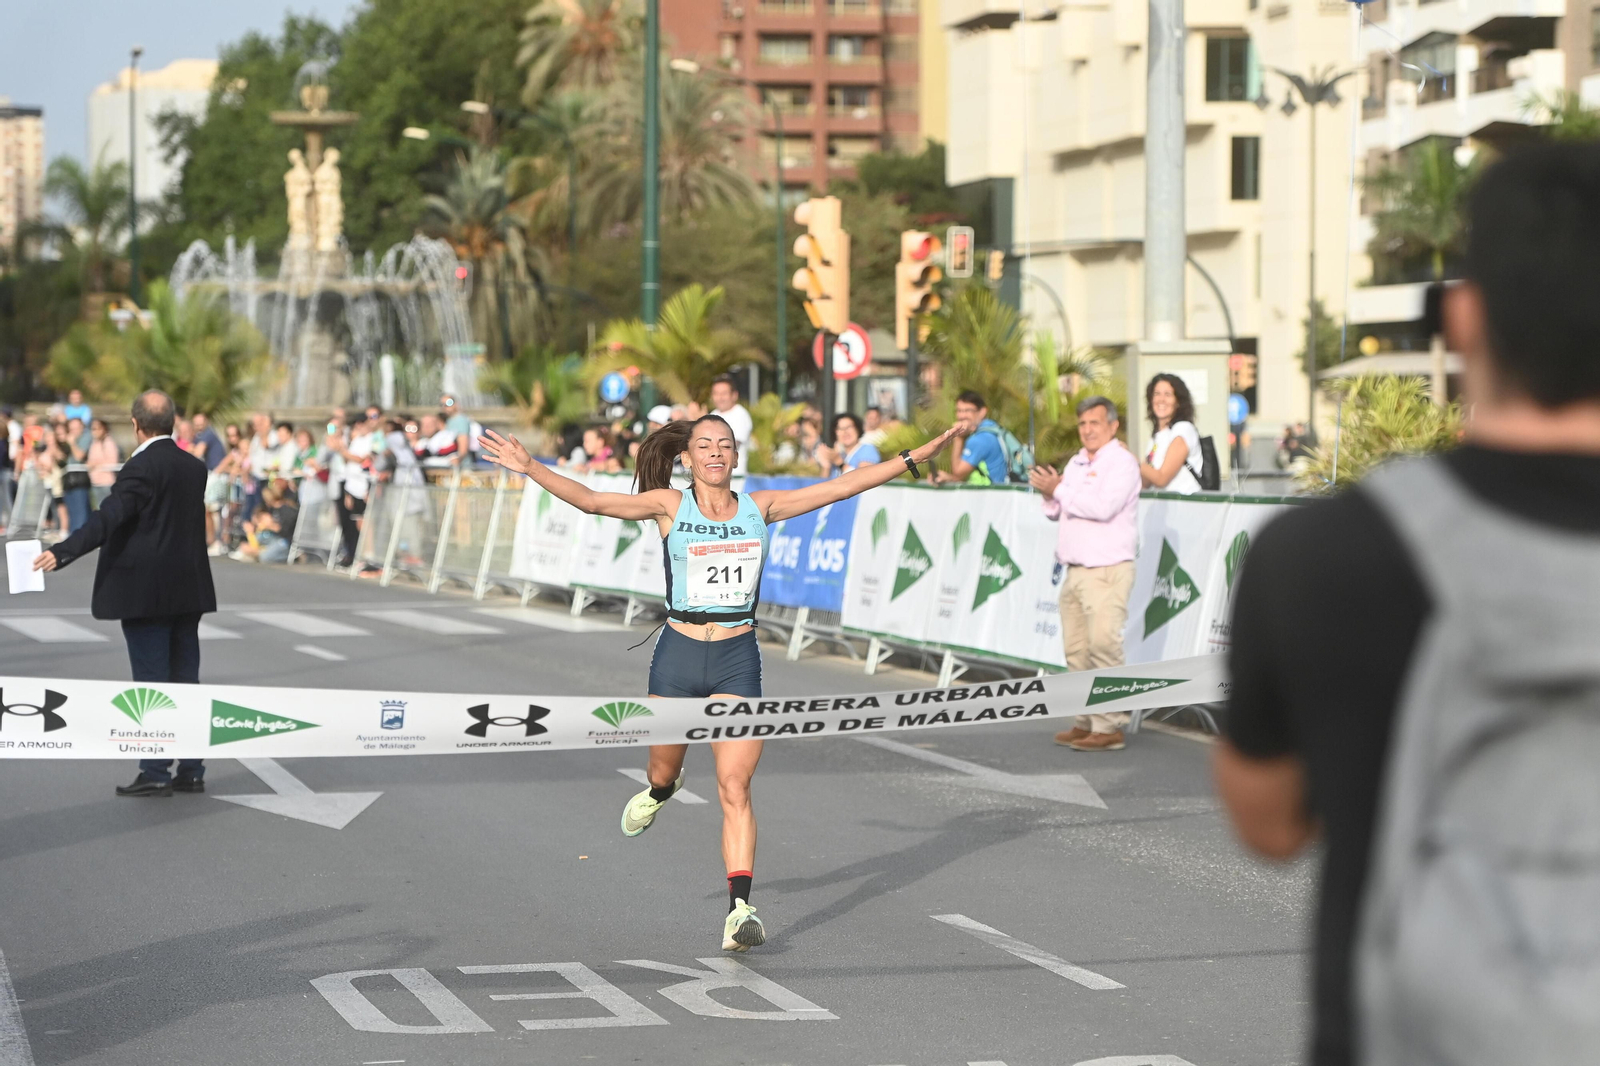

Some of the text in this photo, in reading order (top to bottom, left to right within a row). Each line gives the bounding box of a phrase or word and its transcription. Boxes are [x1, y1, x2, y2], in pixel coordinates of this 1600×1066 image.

[677, 521, 746, 539] nerja
[689, 545, 707, 556] 42
[706, 566, 742, 584] 211
[704, 679, 1046, 717] CARRERA URBANA
[225, 717, 255, 728] Corte
[685, 702, 1050, 740] CIUDAD DE MÁLAGA
[110, 728, 175, 738] Fundación
[355, 734, 426, 743] Ayuntamiento
[588, 729, 650, 737] Fundación
[18, 741, 73, 749] ARMOUR
[119, 743, 165, 754] Unicaja
[382, 741, 416, 750] Málaga
